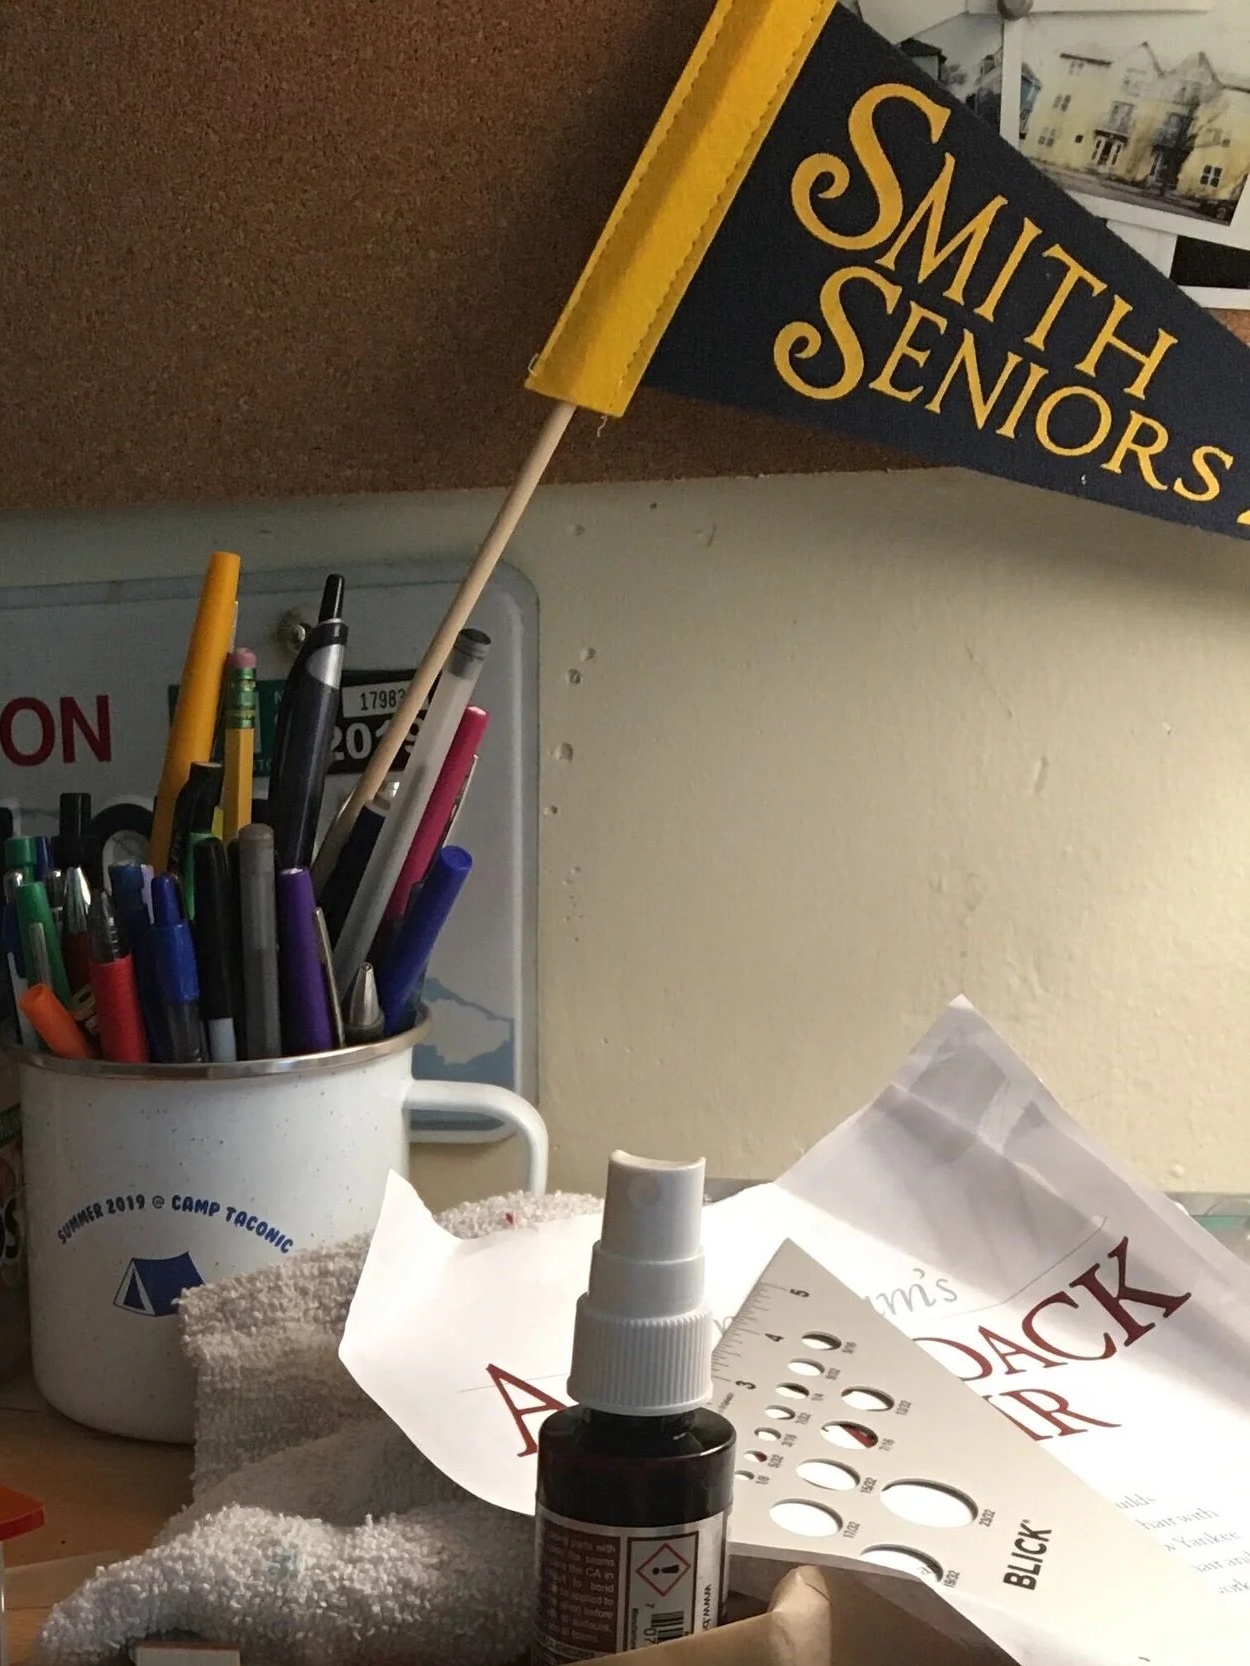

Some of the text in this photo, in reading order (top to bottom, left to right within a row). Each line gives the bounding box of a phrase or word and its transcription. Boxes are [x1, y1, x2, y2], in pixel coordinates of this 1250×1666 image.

[791, 83, 1178, 399] SMITH
[773, 266, 1234, 501] SENIORS
[57, 1202, 104, 1244] SUMMER
[106, 1194, 145, 1214] 2019
[171, 1194, 221, 1217] CAMP
[225, 1206, 294, 1254] TACONIC
[911, 1236, 1192, 1383] DACK
[984, 1387, 1123, 1443] IR
[1113, 1493, 1156, 1510] uilds
[1135, 1517, 1176, 1531] hair
[1003, 1528, 1053, 1591] BLICK
[1173, 1531, 1241, 1549] Yankee
